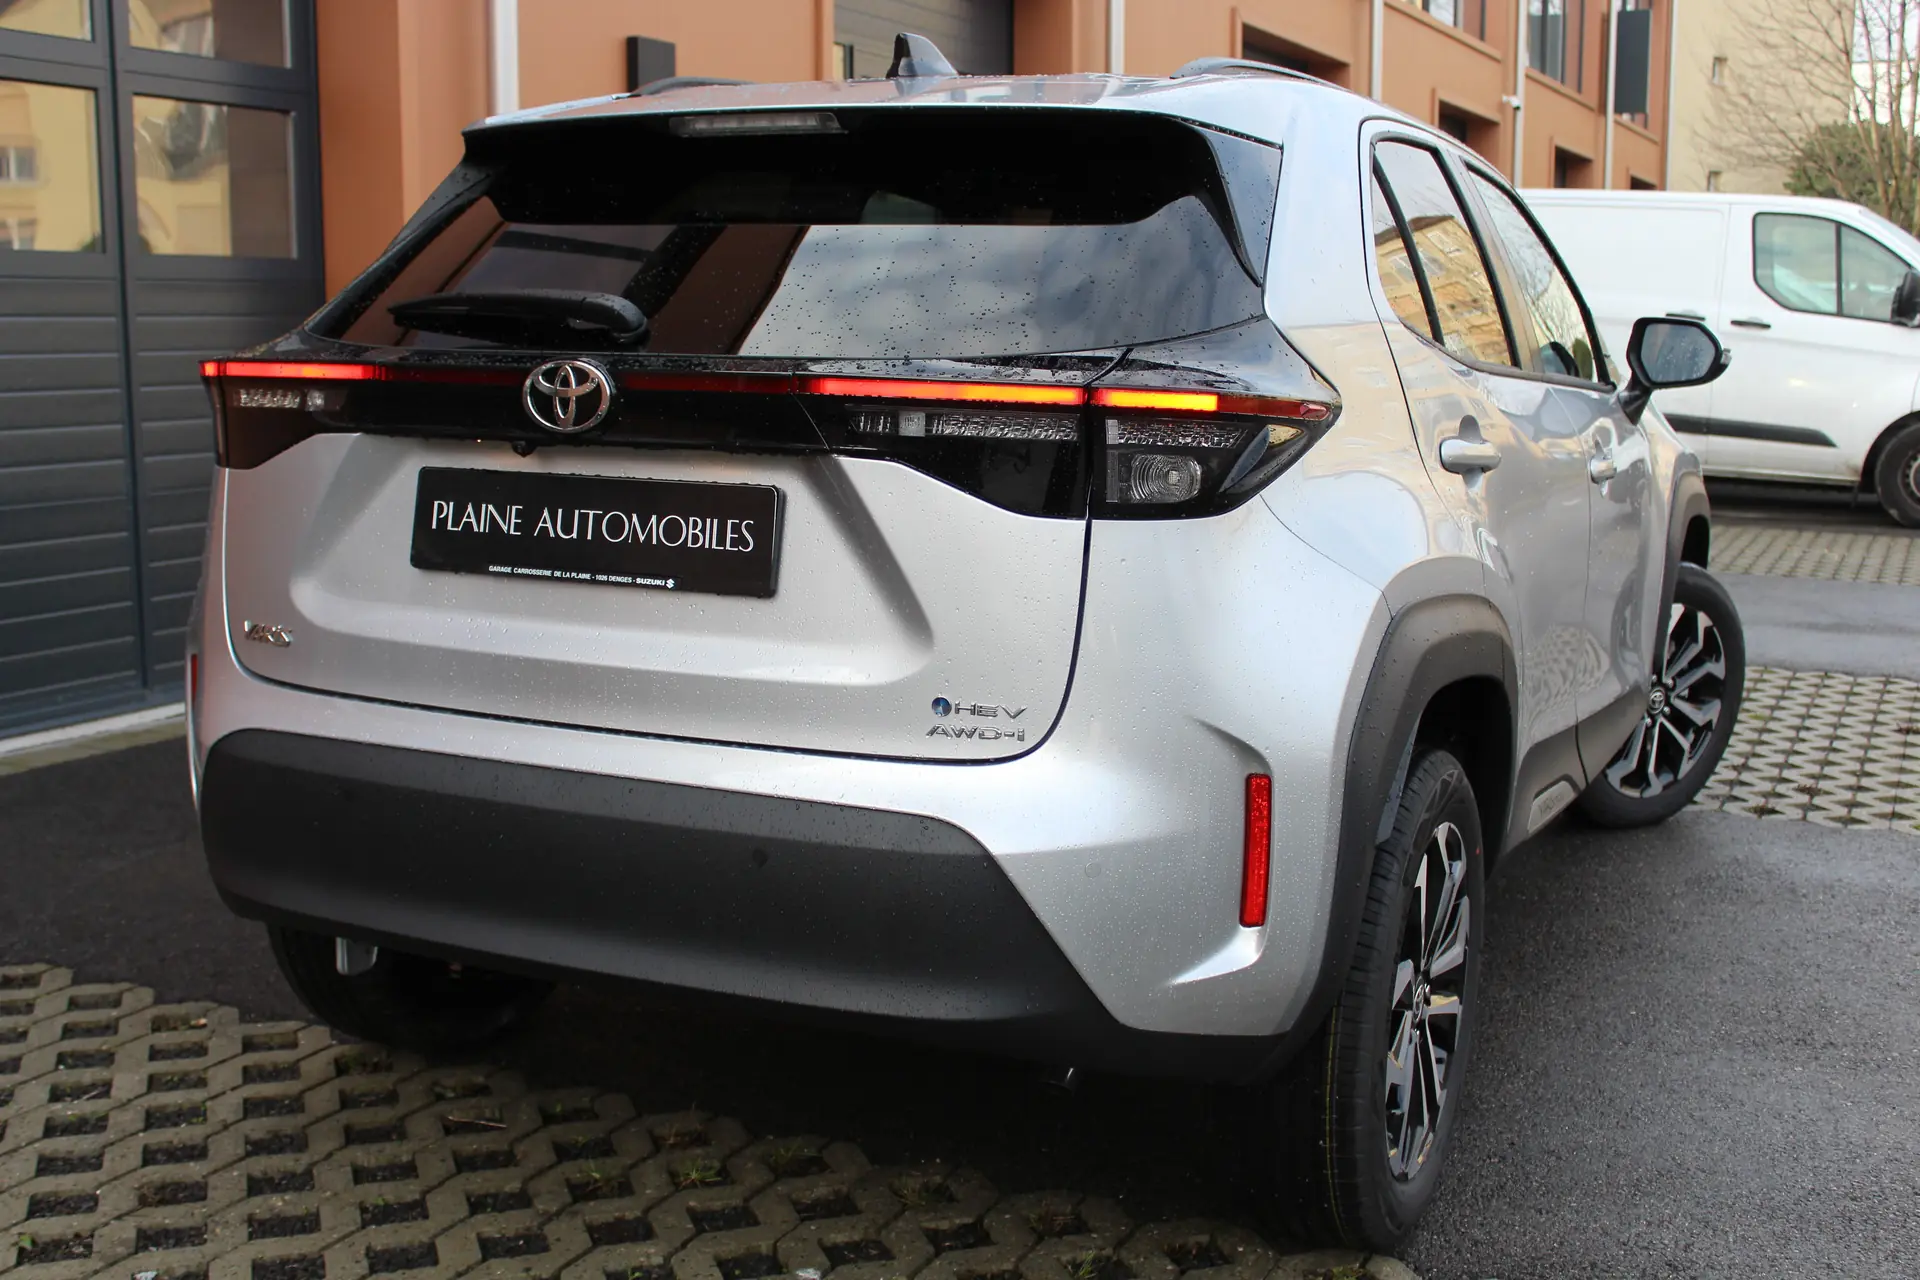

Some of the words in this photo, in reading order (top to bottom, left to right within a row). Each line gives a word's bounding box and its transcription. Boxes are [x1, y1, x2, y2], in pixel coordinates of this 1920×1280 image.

[431, 500, 523, 536] PLAINE
[533, 506, 754, 552] AUTOMOBILES
[488, 565, 513, 574] GARAGE
[513, 567, 552, 577] CARROSSERIE
[553, 570, 562, 578] DE
[570, 572, 592, 580] PLAINE
[608, 575, 633, 584] DENGES
[636, 577, 665, 586] SUZUKI
[954, 701, 1028, 719] HEV
